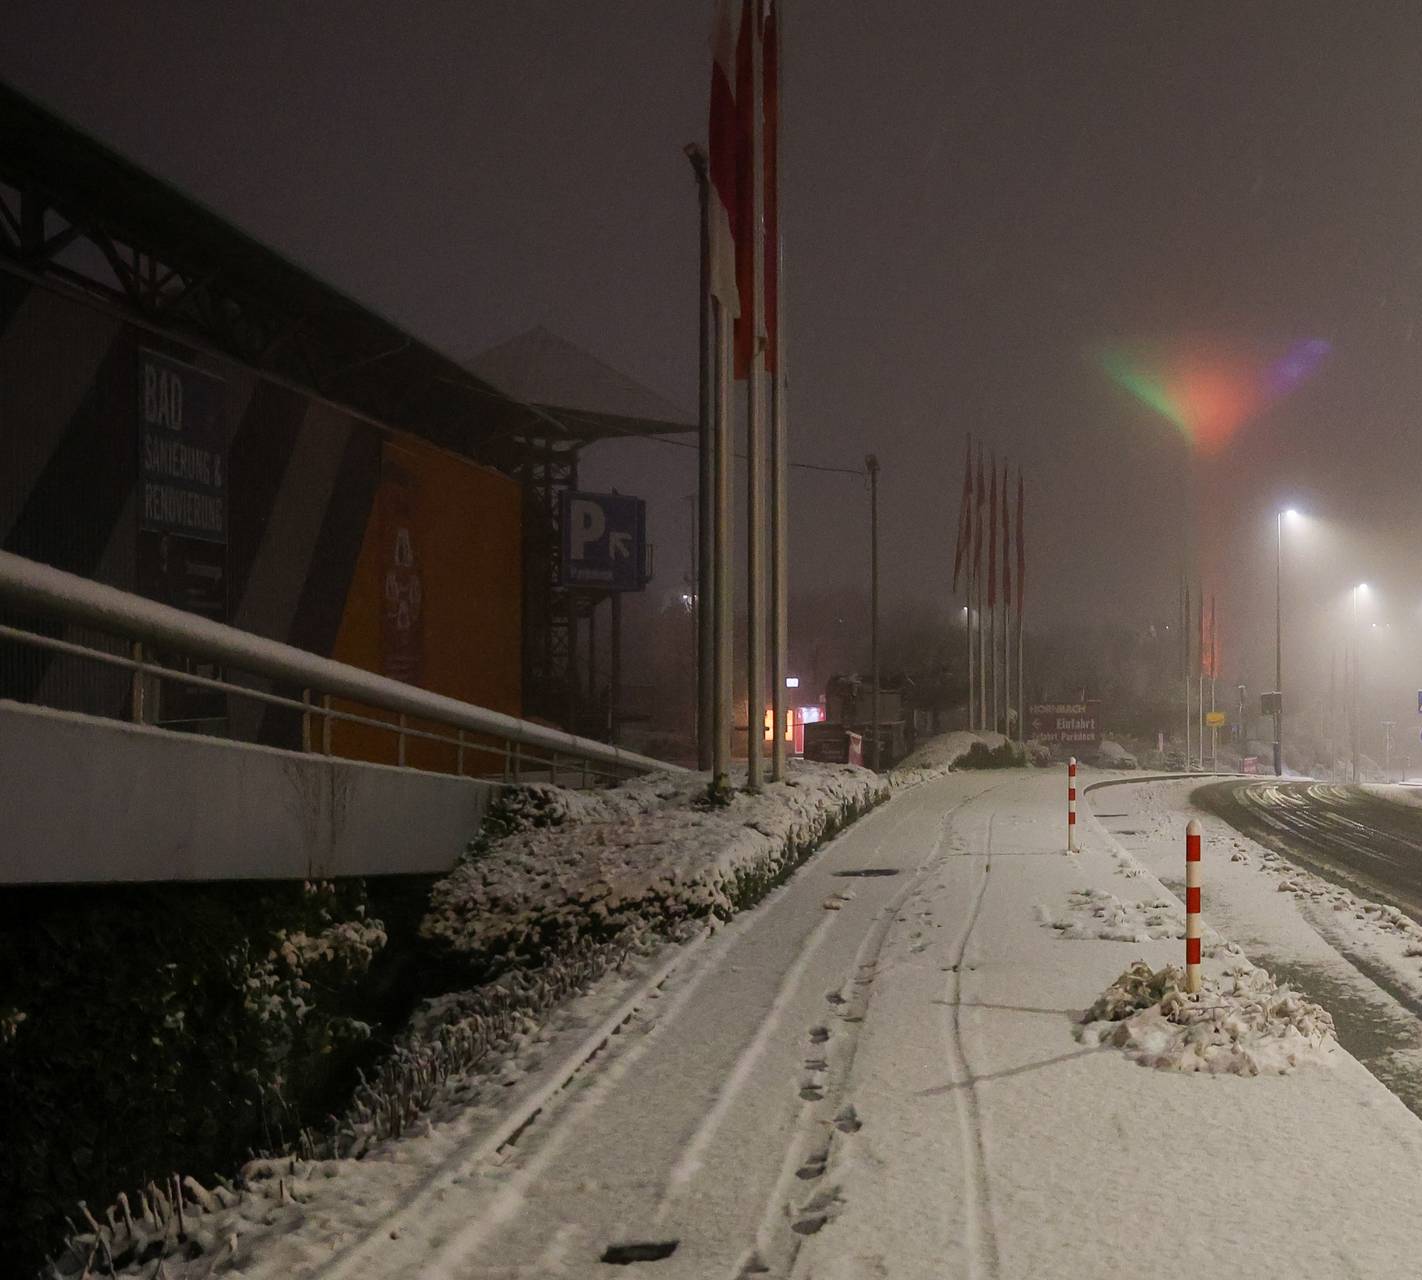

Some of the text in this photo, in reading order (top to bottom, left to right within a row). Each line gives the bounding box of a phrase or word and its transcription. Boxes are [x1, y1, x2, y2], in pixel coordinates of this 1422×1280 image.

[144, 363, 184, 431] BAD
[144, 434, 223, 489] SANIERUNG &
[144, 479, 224, 532] RENOVIERUNG
[570, 500, 606, 560] P
[1056, 718, 1095, 729] Einfahrt
